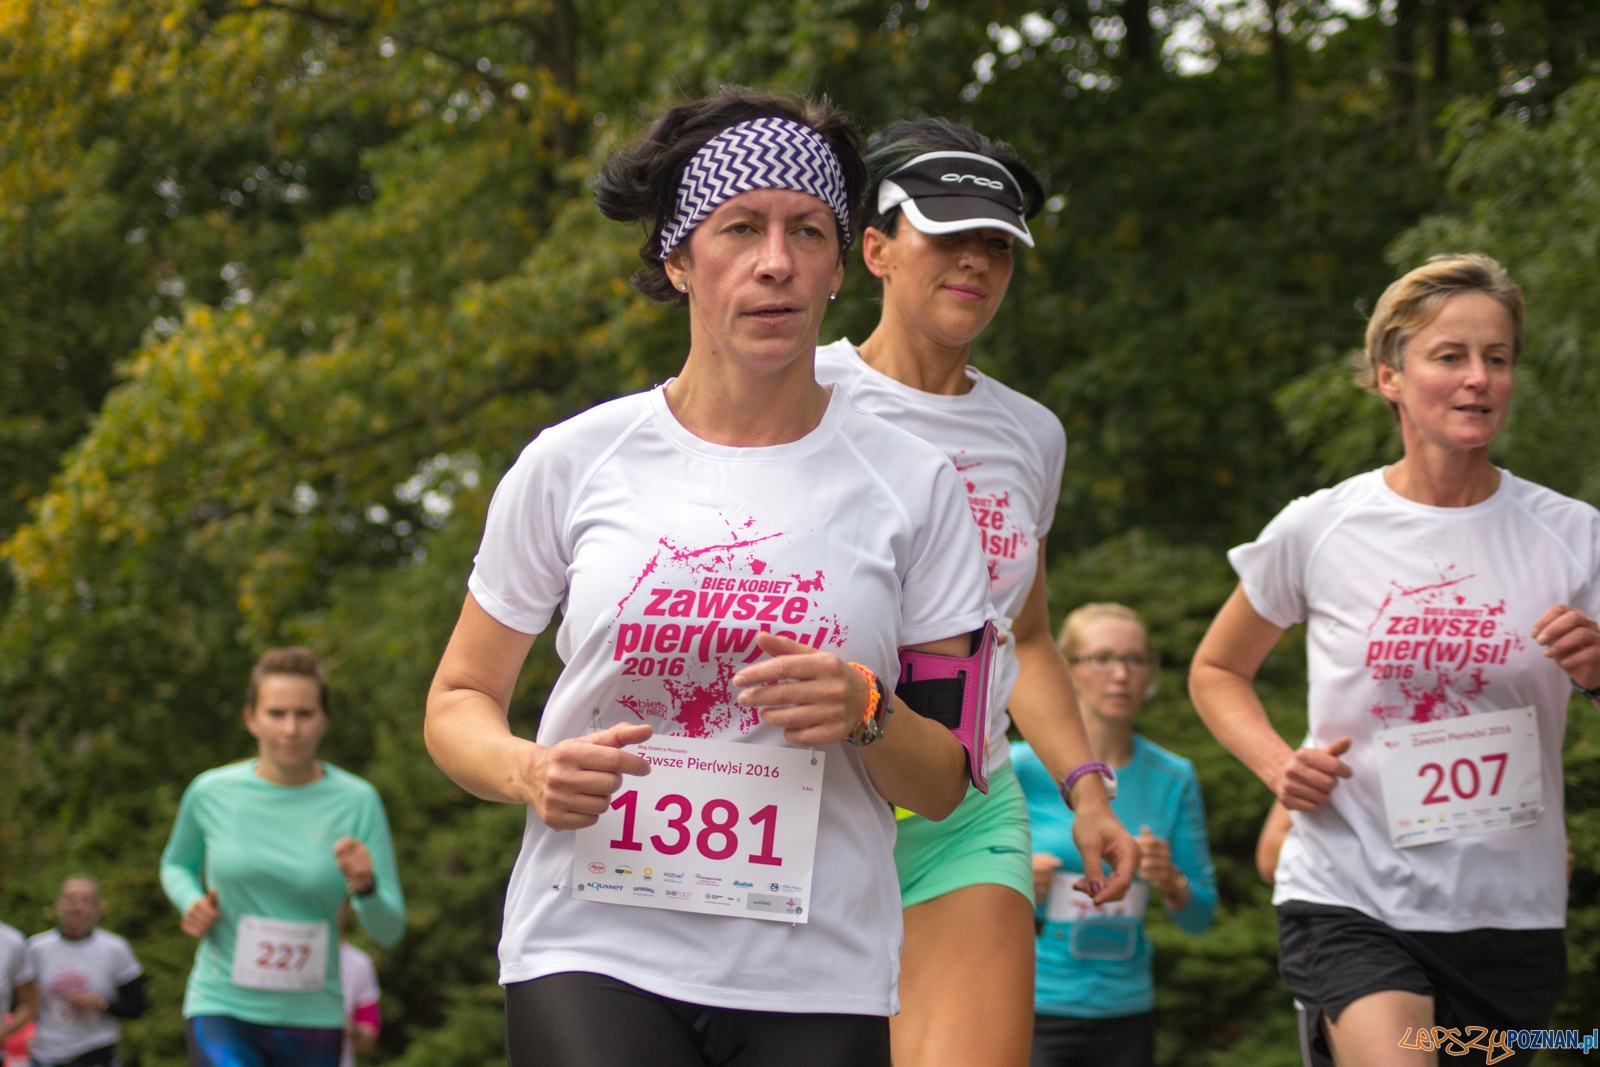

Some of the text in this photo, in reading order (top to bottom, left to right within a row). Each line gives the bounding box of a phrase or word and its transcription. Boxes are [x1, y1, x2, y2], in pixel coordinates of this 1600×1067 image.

[941, 173, 1004, 190] orca
[701, 576, 792, 594] BIEG KOBIET
[643, 588, 809, 624] zawsze
[1385, 616, 1497, 638] zawsze
[1365, 638, 1512, 671] pier(w)si!
[621, 657, 686, 677] 2016
[1371, 663, 1415, 680] 2016
[687, 756, 742, 774] Pier(w)si
[745, 763, 780, 778] 2016
[1417, 752, 1510, 806] 207
[609, 789, 783, 867] 1381
[255, 941, 312, 972] 227
